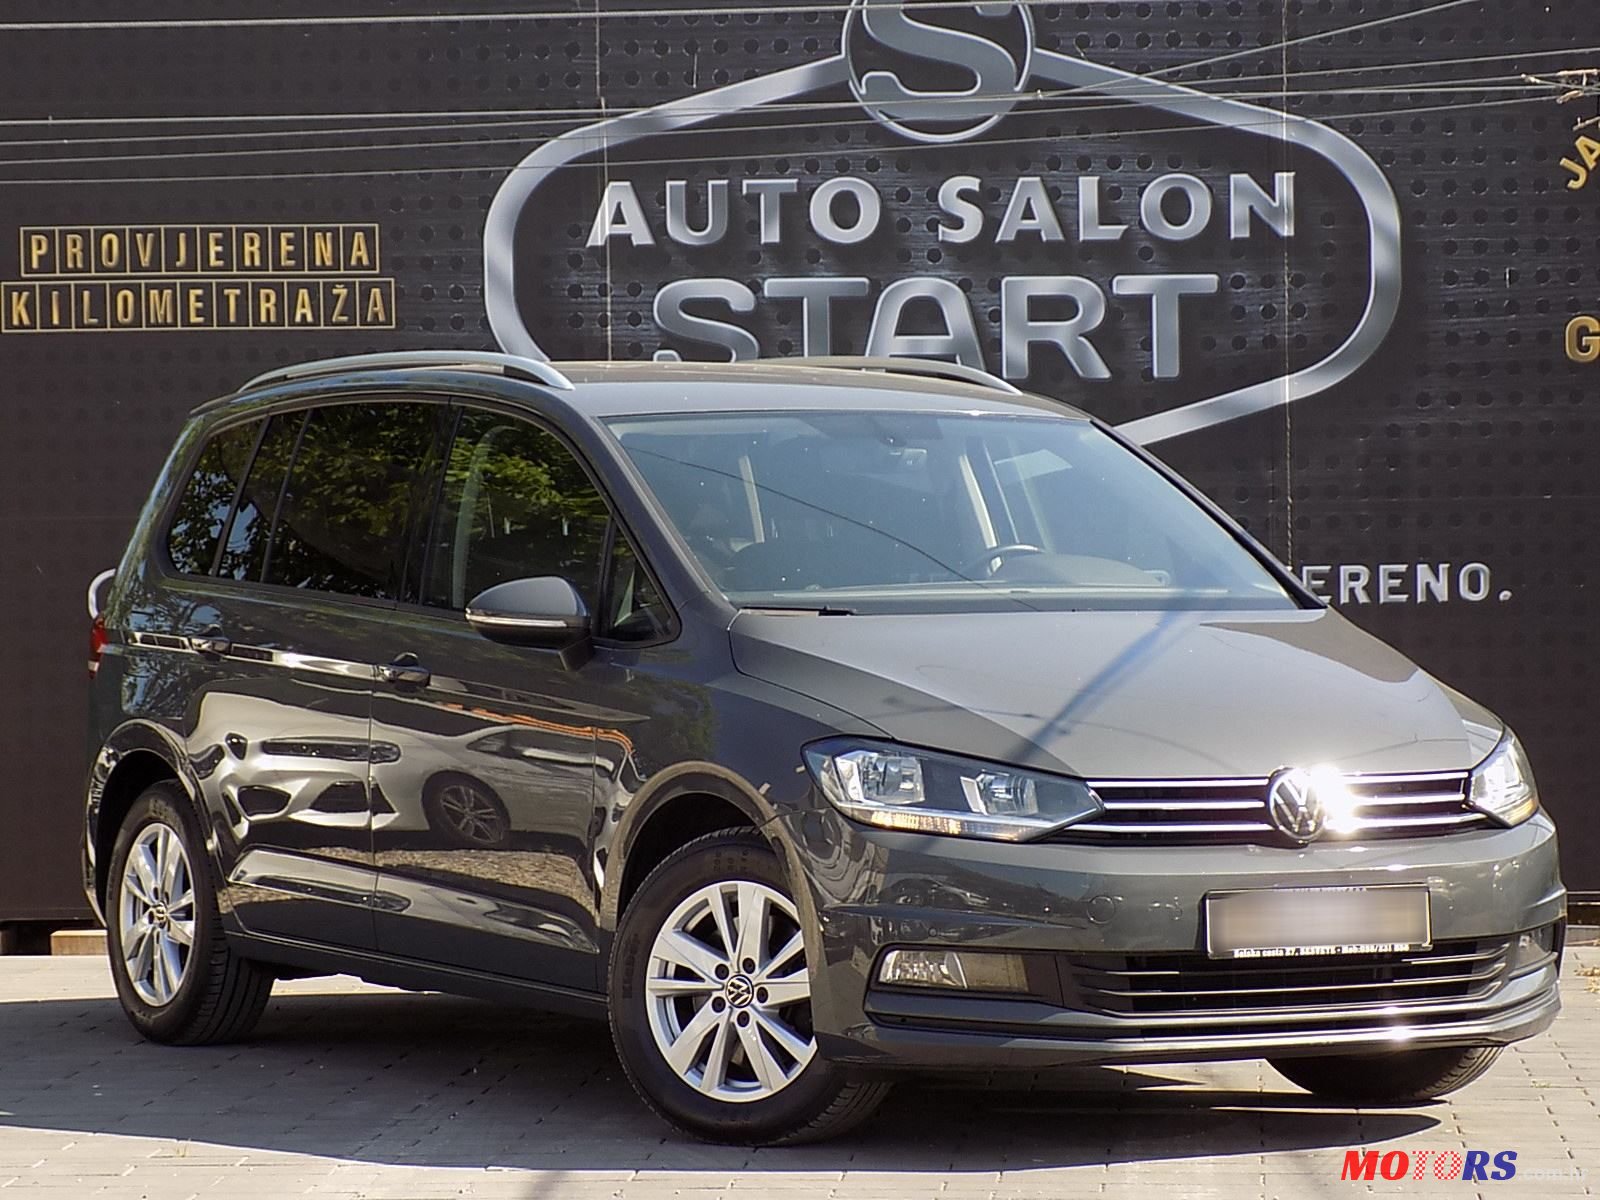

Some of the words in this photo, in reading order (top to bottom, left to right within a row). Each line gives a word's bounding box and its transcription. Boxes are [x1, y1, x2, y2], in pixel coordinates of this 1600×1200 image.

[585, 176, 881, 248] AUTO
[937, 171, 1296, 244] SALON
[30, 231, 370, 269] PROVJERENA
[10, 284, 386, 326] KILOMETRAŽA
[652, 274, 1219, 380] START
[1286, 562, 1512, 604] ERENO.
